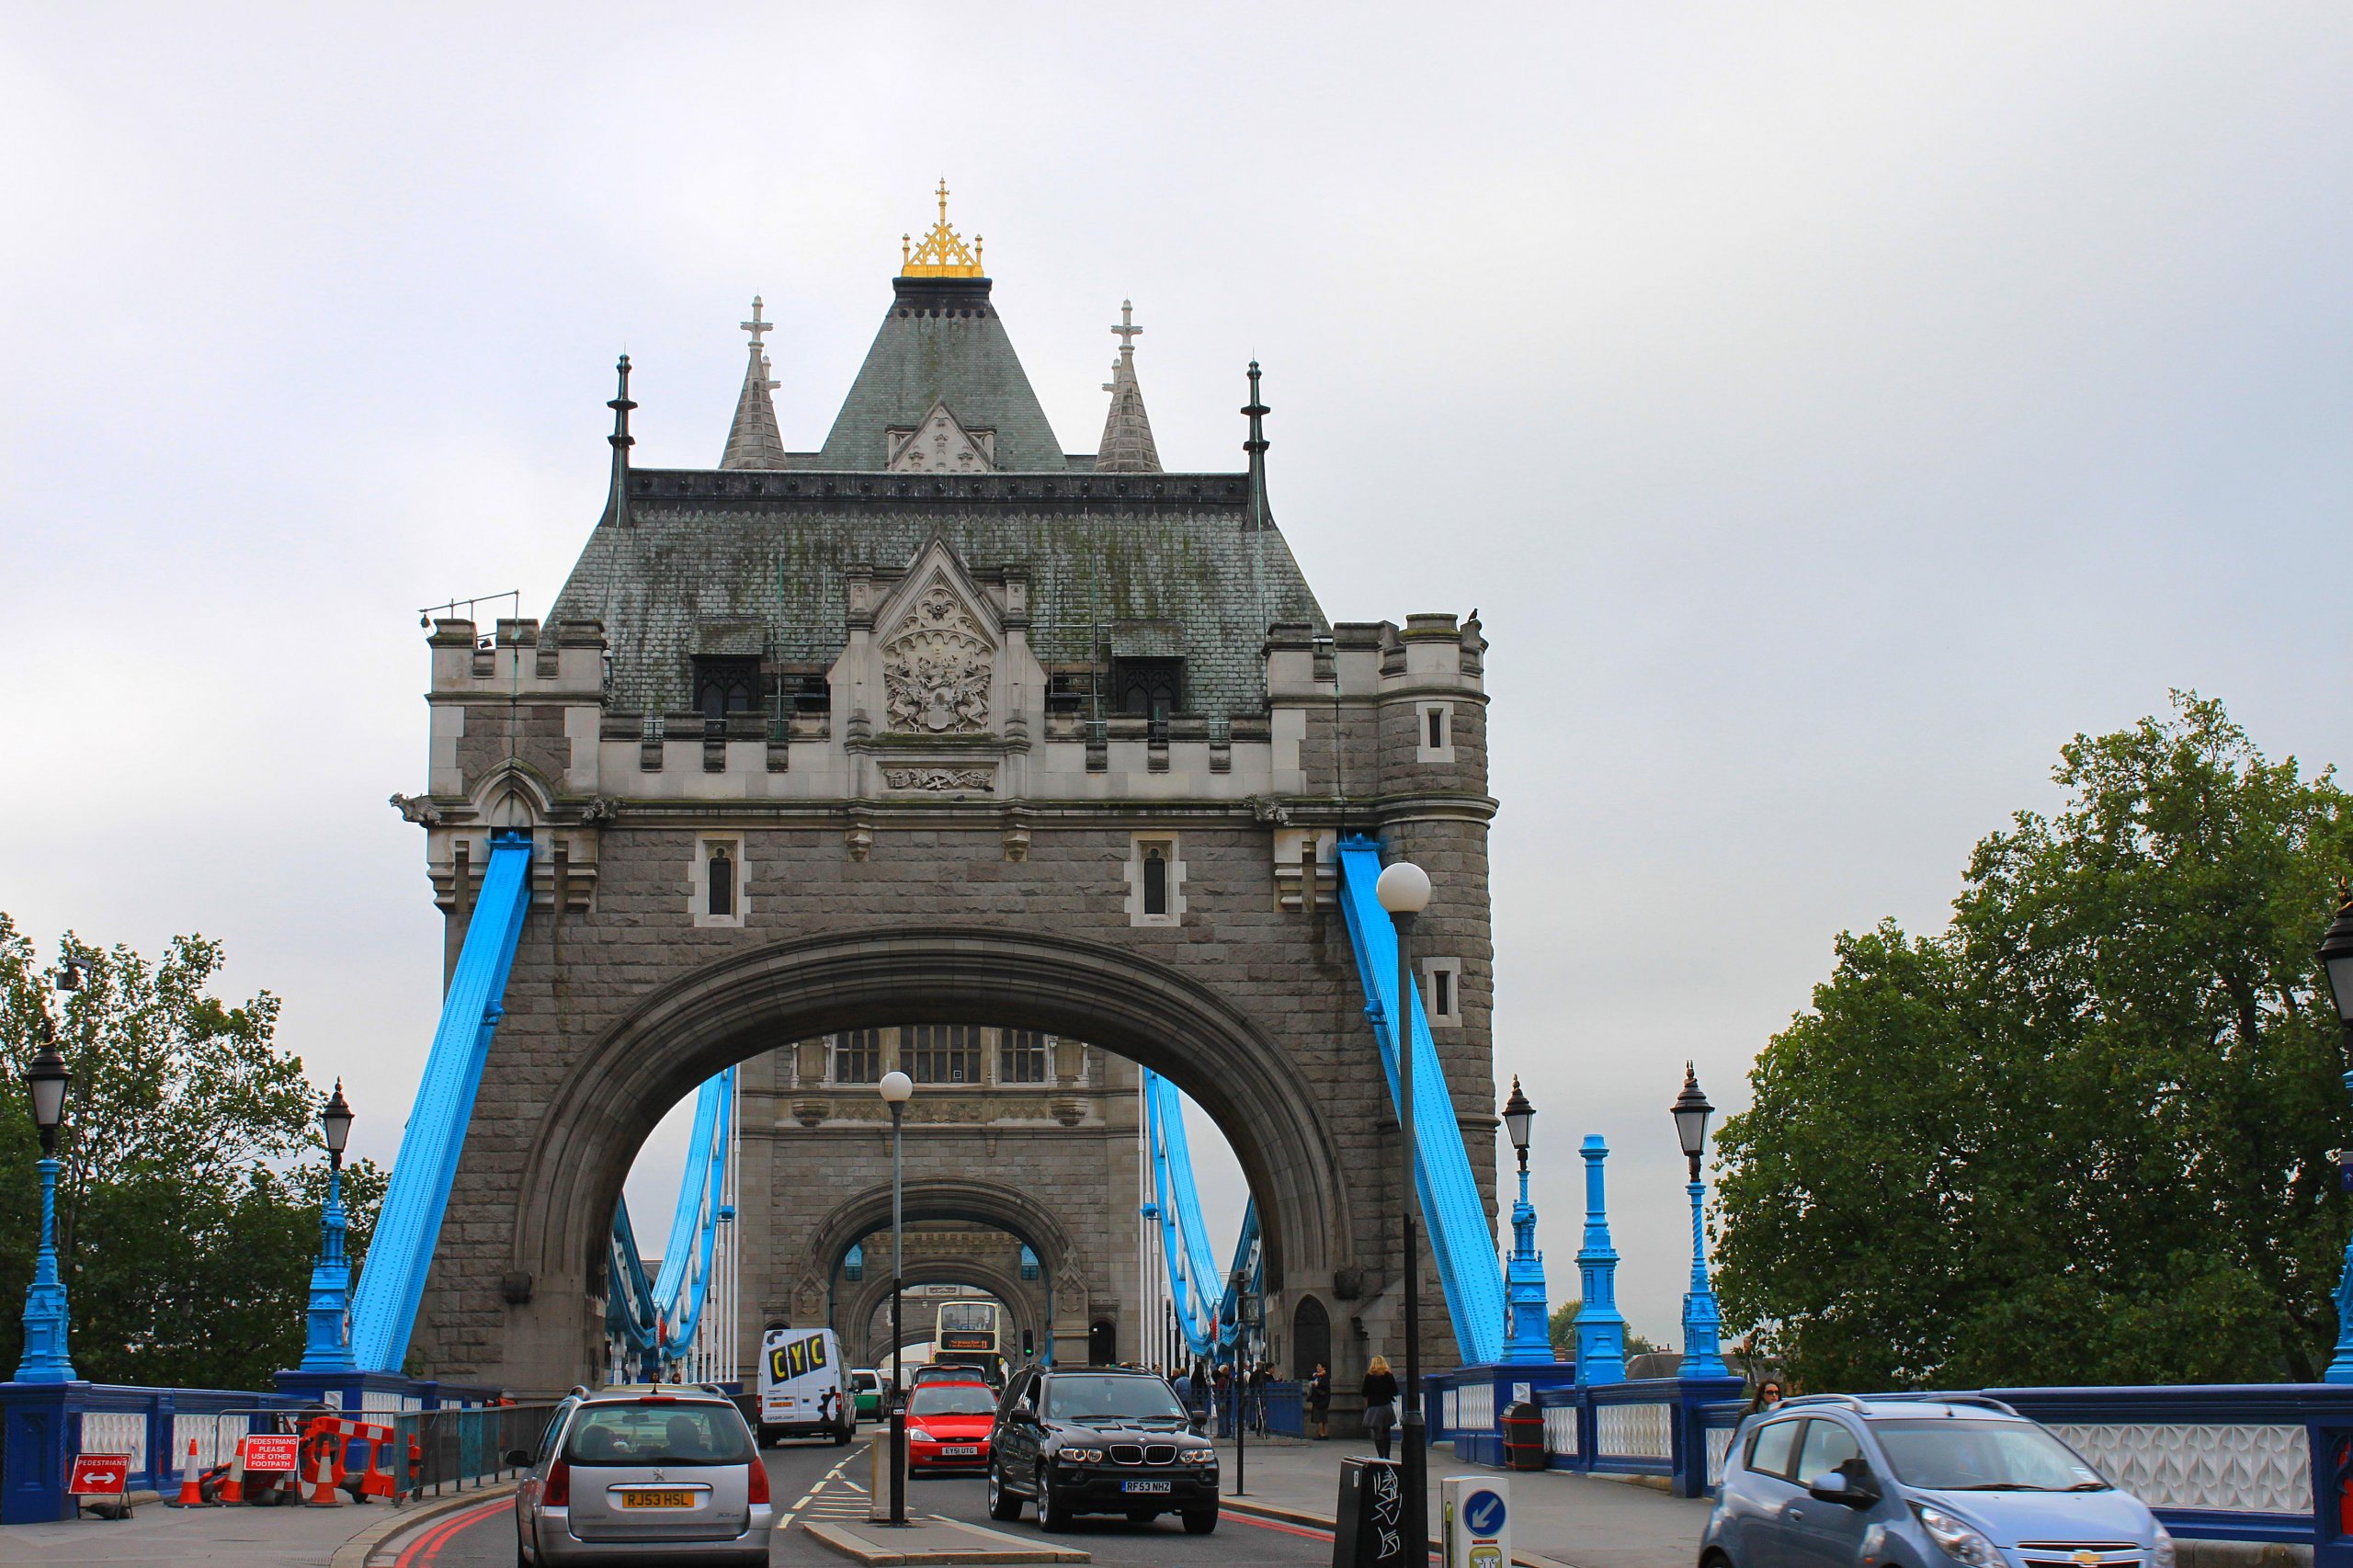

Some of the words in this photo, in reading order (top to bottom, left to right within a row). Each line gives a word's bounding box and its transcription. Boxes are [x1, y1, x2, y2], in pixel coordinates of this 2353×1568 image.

[774, 1337, 824, 1378] CYC
[1127, 1482, 1151, 1492] RF53
[1152, 1482, 1170, 1492] NHZ
[628, 1494, 661, 1506] RJ53
[664, 1494, 689, 1506] HSL
